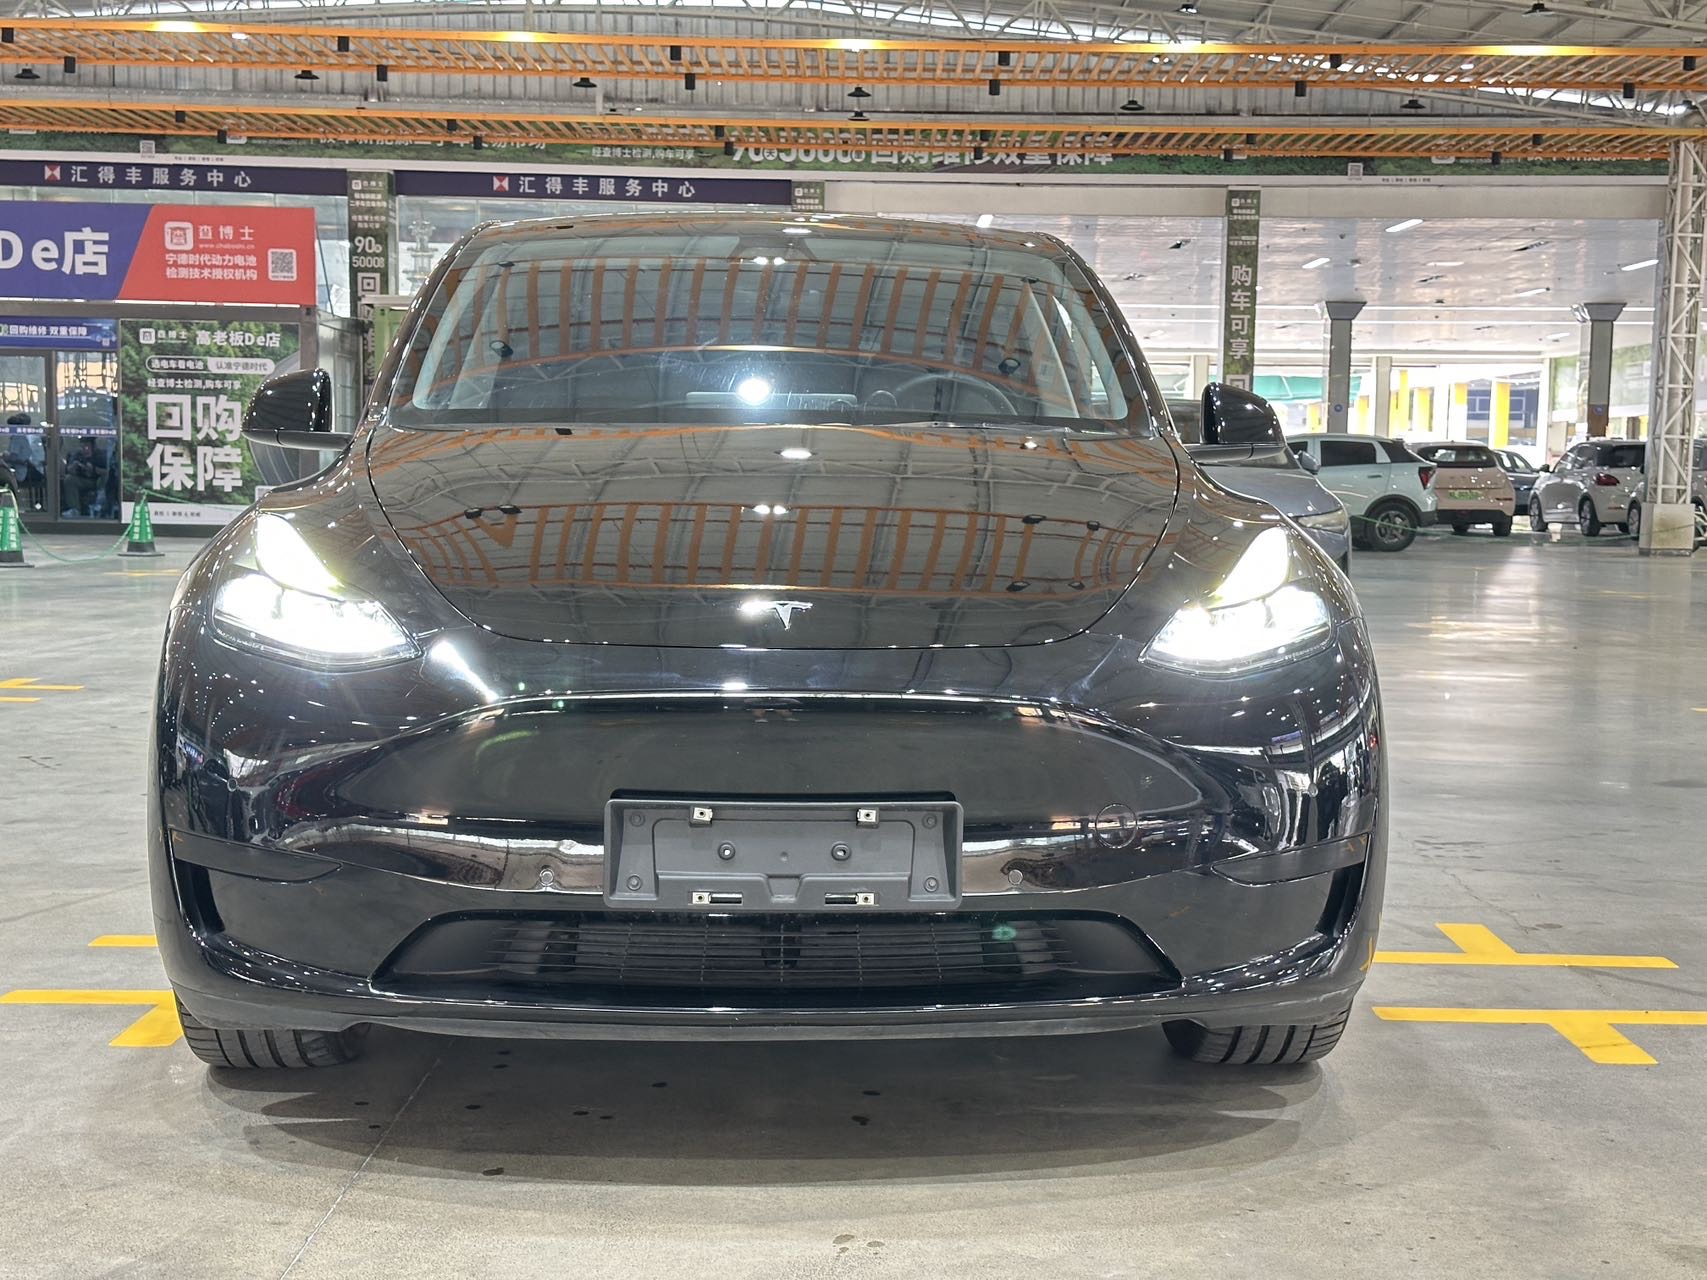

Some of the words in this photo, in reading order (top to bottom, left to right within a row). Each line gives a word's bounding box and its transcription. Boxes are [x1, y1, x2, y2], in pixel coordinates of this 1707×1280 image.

[70, 165, 252, 188] 汇得丰服务中心
[519, 175, 695, 198] 汇得丰服务中心
[165, 252, 257, 267] 宁德时代动力电池
[166, 266, 257, 281] 检测技术授权机构
[1229, 265, 1252, 360] 购车可享
[195, 329, 281, 348] 高老板De店
[147, 394, 242, 442] 回购
[146, 443, 243, 492] 保障
